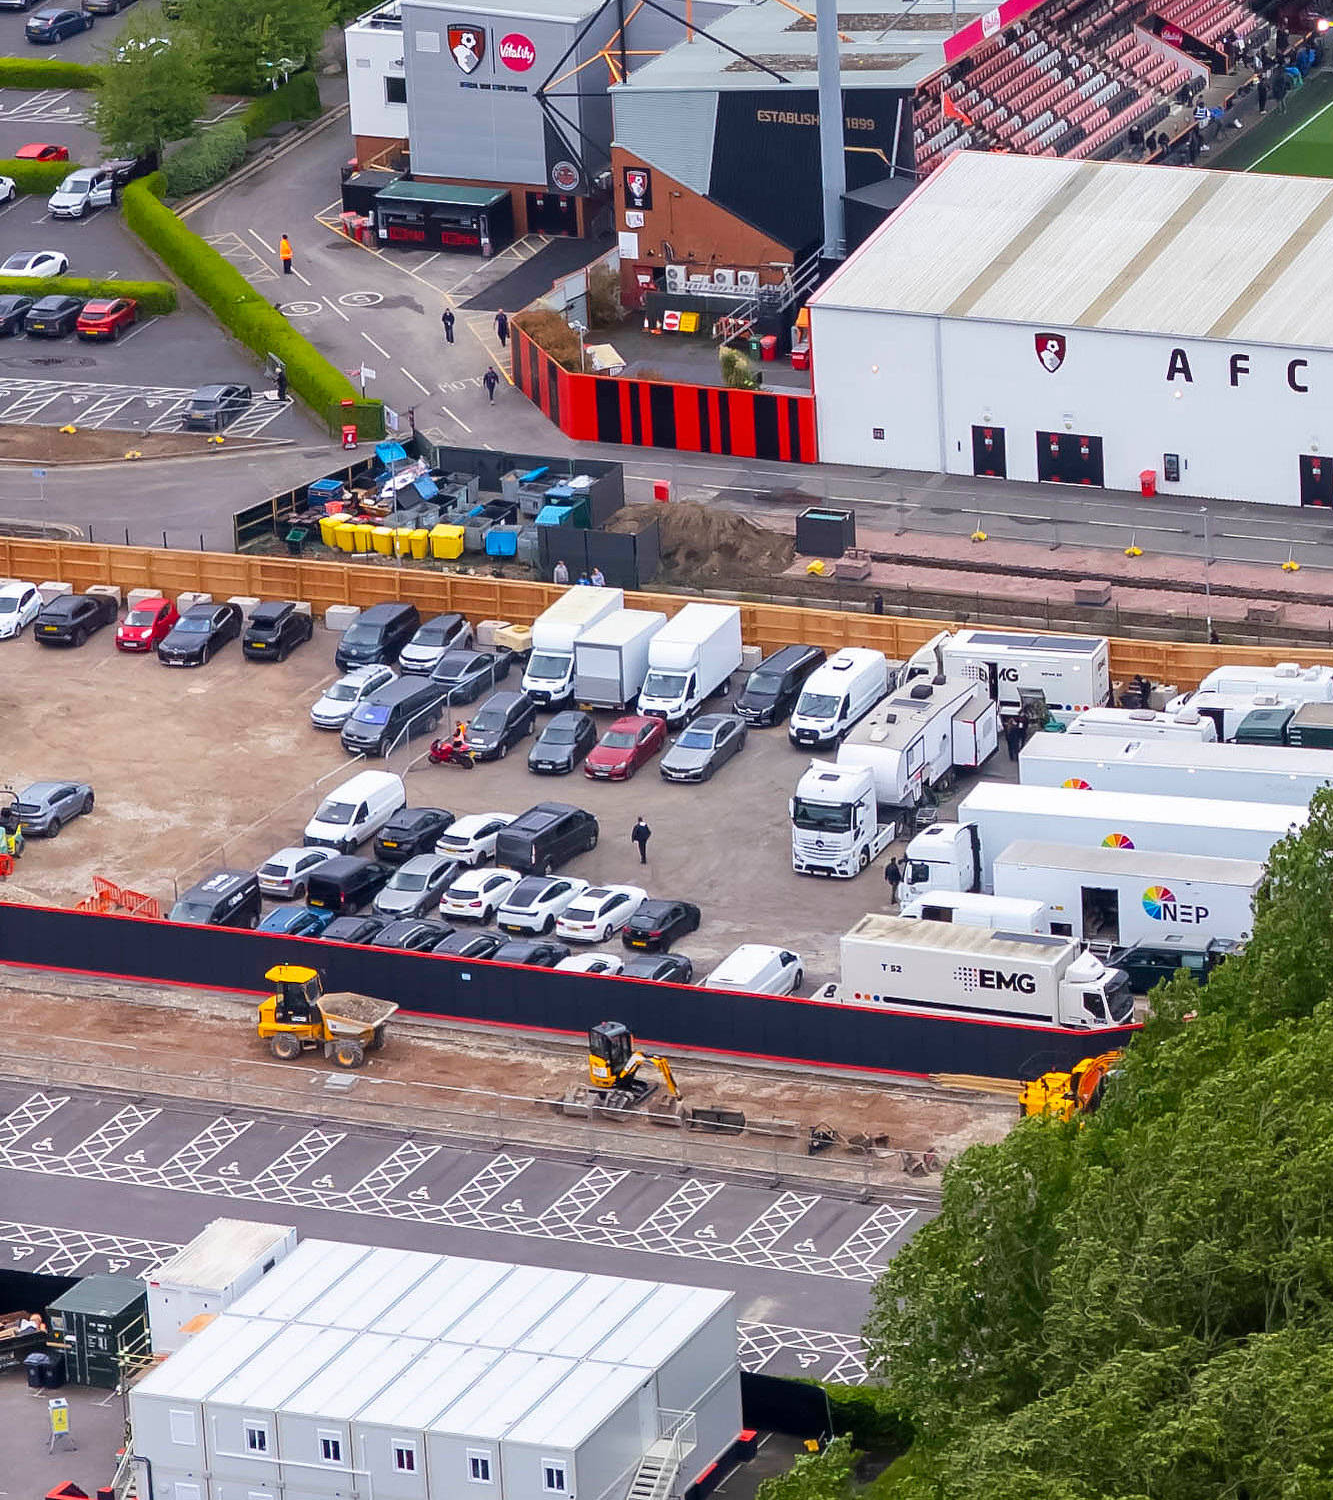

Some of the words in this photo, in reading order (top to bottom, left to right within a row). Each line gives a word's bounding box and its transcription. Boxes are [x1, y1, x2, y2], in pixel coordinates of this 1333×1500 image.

[499, 41, 535, 64] Vitality
[757, 109, 820, 127] ESTABLISH
[845, 116, 875, 131] 1899
[1165, 347, 1309, 394] AFC
[1162, 902, 1210, 924] NEP
[880, 962, 889, 972] T
[978, 968, 1036, 995] EMG
